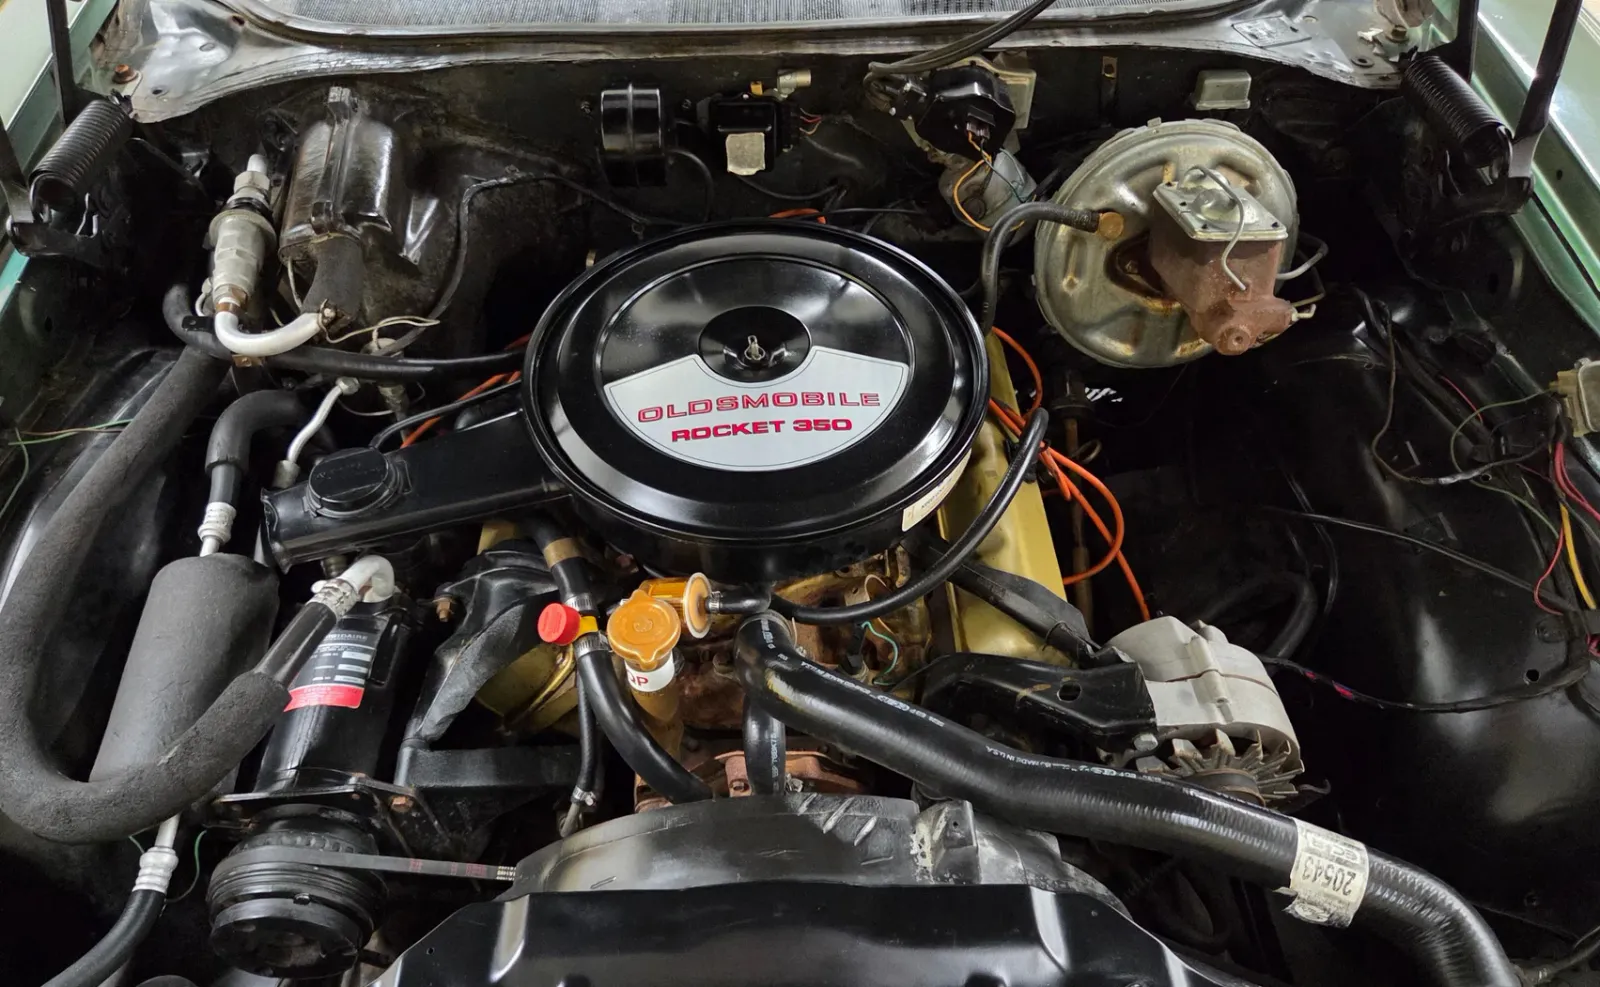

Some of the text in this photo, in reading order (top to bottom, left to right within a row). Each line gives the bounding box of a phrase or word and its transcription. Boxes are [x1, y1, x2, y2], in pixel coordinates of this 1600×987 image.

[638, 391, 881, 422] OLDSMOBILE
[671, 418, 853, 442] ROCKET 350
[1301, 855, 1357, 897] 20543
